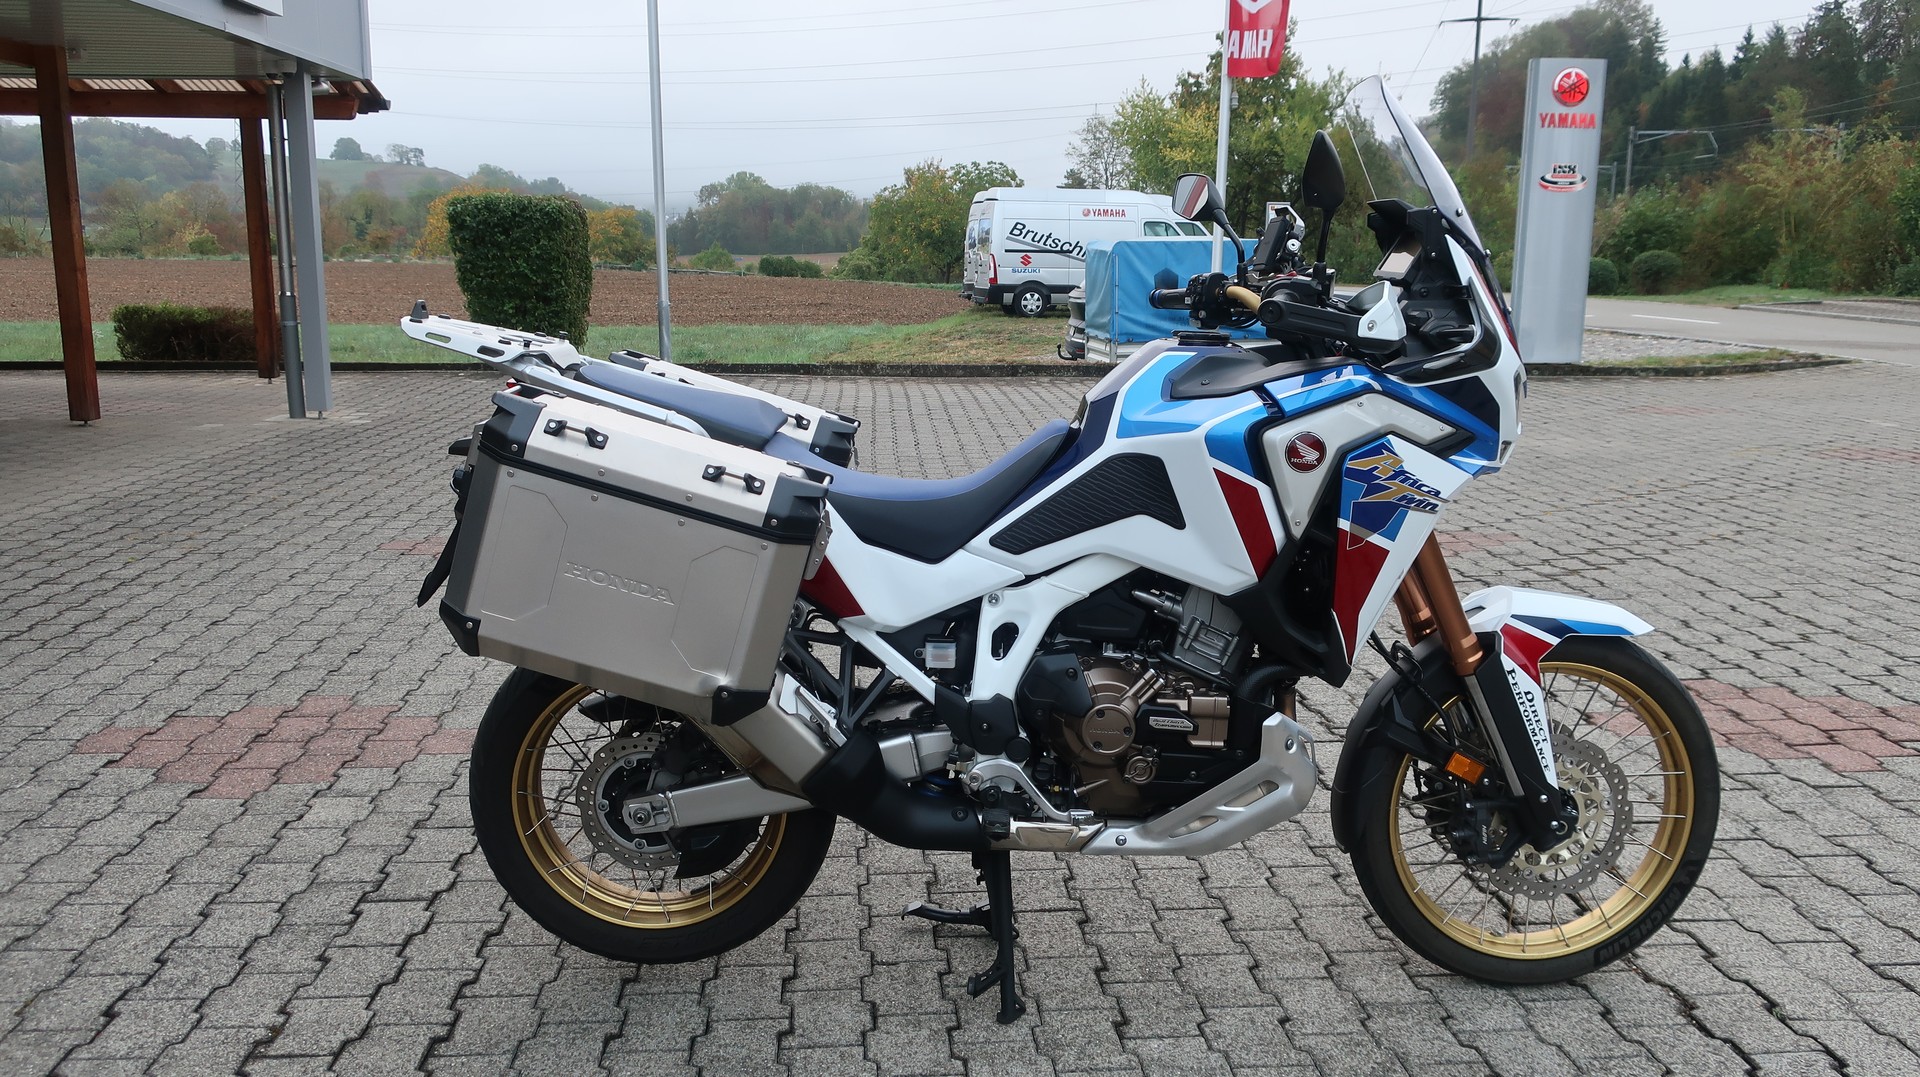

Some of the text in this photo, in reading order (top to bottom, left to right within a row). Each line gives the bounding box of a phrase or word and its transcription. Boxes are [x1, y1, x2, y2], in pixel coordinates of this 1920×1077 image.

[1539, 112, 1597, 129] YAMAHA
[1092, 208, 1126, 218] YAMAHA
[1290, 457, 1319, 466] HONDA
[1346, 449, 1443, 498] Africa
[1359, 480, 1450, 514] Twin
[564, 561, 675, 606] HONDA
[1506, 667, 1551, 773] PERFORMANCE
[1523, 690, 1549, 744] DIRECT
